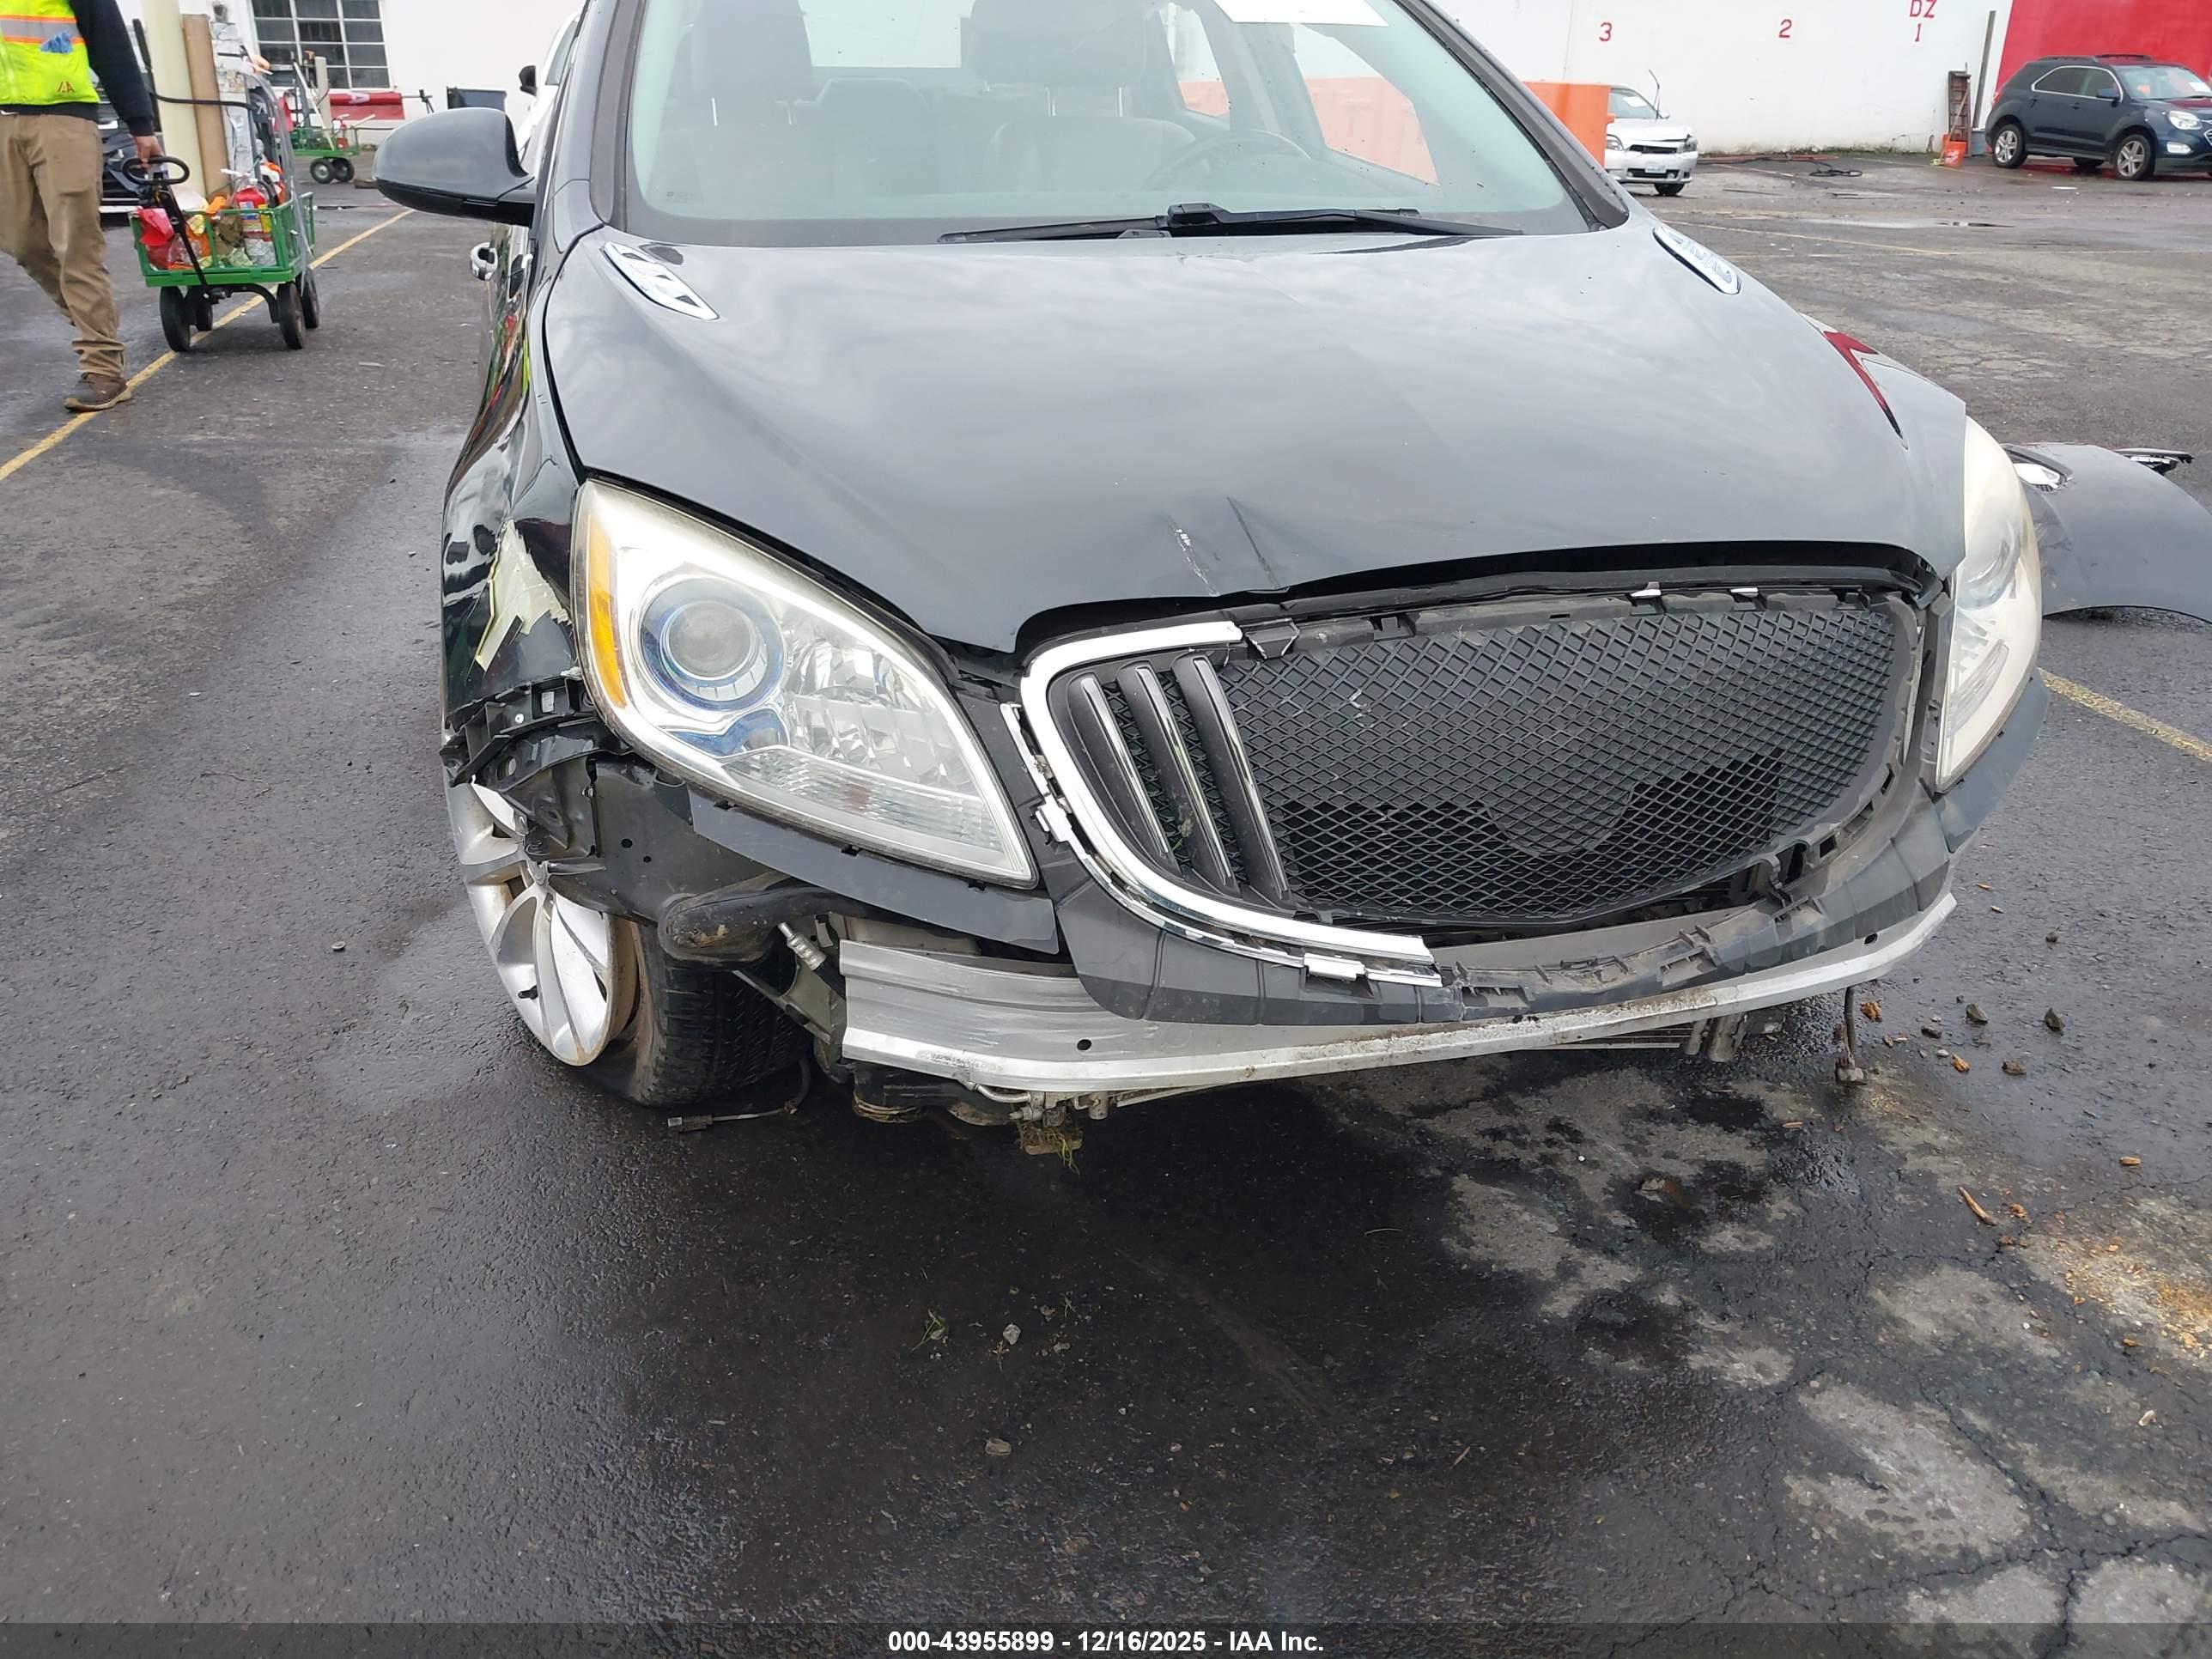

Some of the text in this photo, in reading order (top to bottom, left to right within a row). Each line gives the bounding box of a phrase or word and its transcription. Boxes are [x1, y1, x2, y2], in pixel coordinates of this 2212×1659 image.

[1910, 0, 1937, 18] DZ
[1599, 21, 1613, 41] 3
[1778, 19, 1792, 39] 2
[1915, 23, 1922, 42] 1
